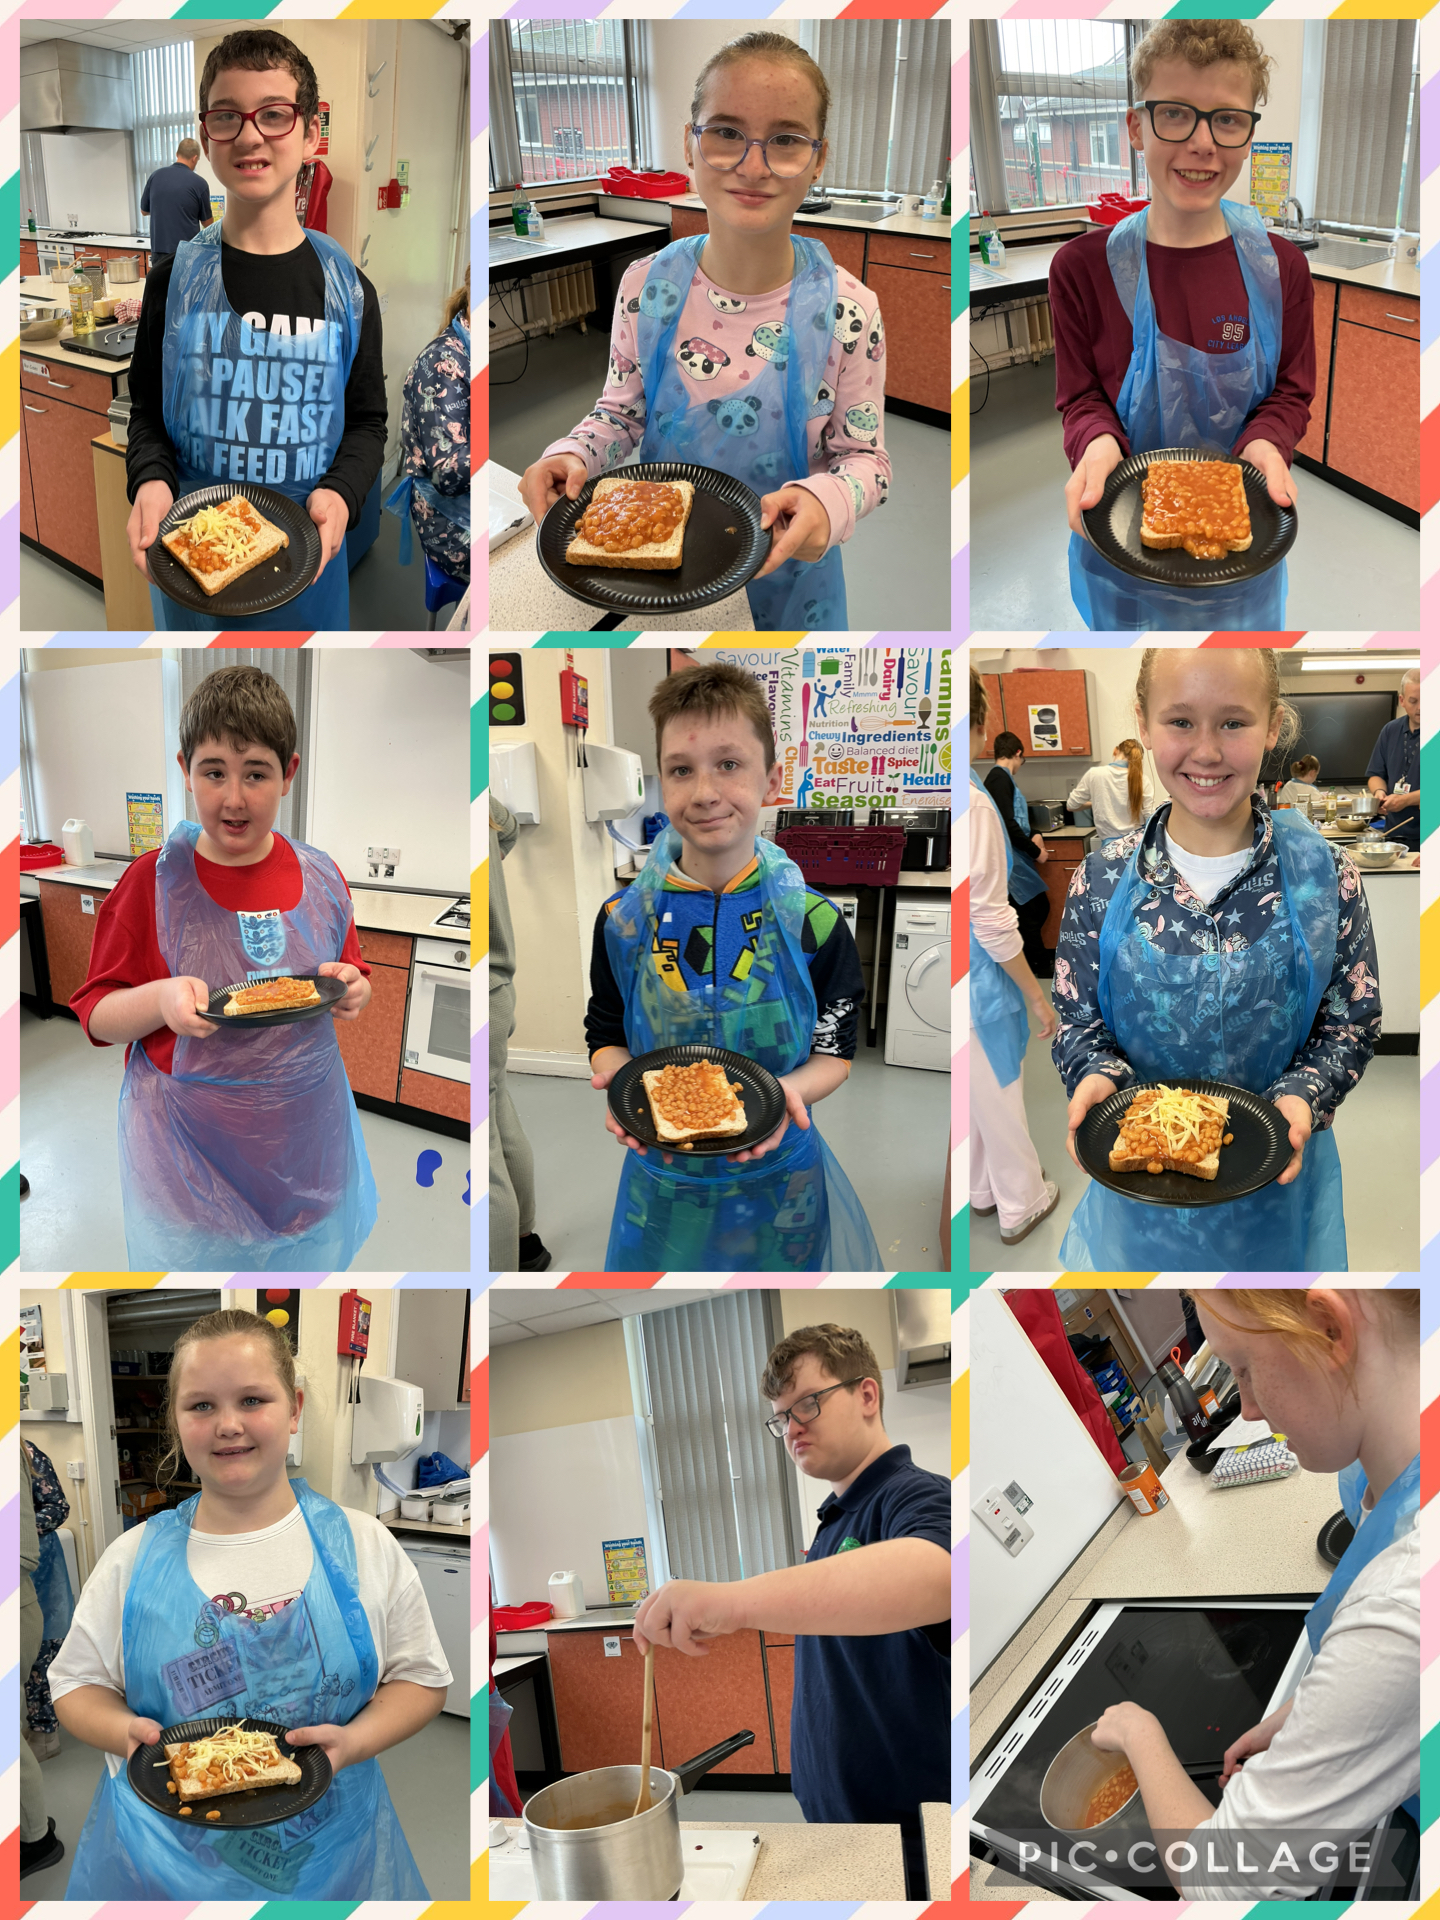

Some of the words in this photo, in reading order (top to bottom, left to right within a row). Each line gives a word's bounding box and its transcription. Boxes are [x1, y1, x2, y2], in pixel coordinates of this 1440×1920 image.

[1211, 315, 1226, 324] LOS
[1222, 322, 1245, 342] 95
[1207, 339, 1224, 349] CITY
[184, 397, 250, 442] ALK
[260, 402, 335, 445] FAST
[213, 441, 287, 484] FEED
[294, 441, 329, 482] ME
[715, 651, 781, 666] Savour
[752, 671, 768, 681] ice
[840, 654, 856, 698] Family
[878, 658, 896, 701] Dairy
[904, 648, 924, 719] Savour
[780, 648, 800, 742] Vitamins
[827, 699, 897, 718] Refreshing
[808, 720, 849, 728] Nutrition
[808, 730, 841, 742] Chewy
[842, 730, 932, 746] Ingredients
[846, 746, 896, 756] Balanced
[898, 745, 919, 755] diet
[781, 746, 798, 795] Chewy
[812, 756, 870, 775] Taste
[887, 757, 919, 770] Spice
[814, 777, 836, 788] Eat
[836, 776, 884, 794] Fruit
[810, 791, 897, 808] Season
[1192, 1413, 1202, 1426] air
[1200, 1416, 1208, 1428] up
[204, 1681, 226, 1696] ADMIT
[250, 1830, 287, 1855] CIRC
[239, 1837, 292, 1871] TICKET
[262, 1871, 279, 1882] ONE
